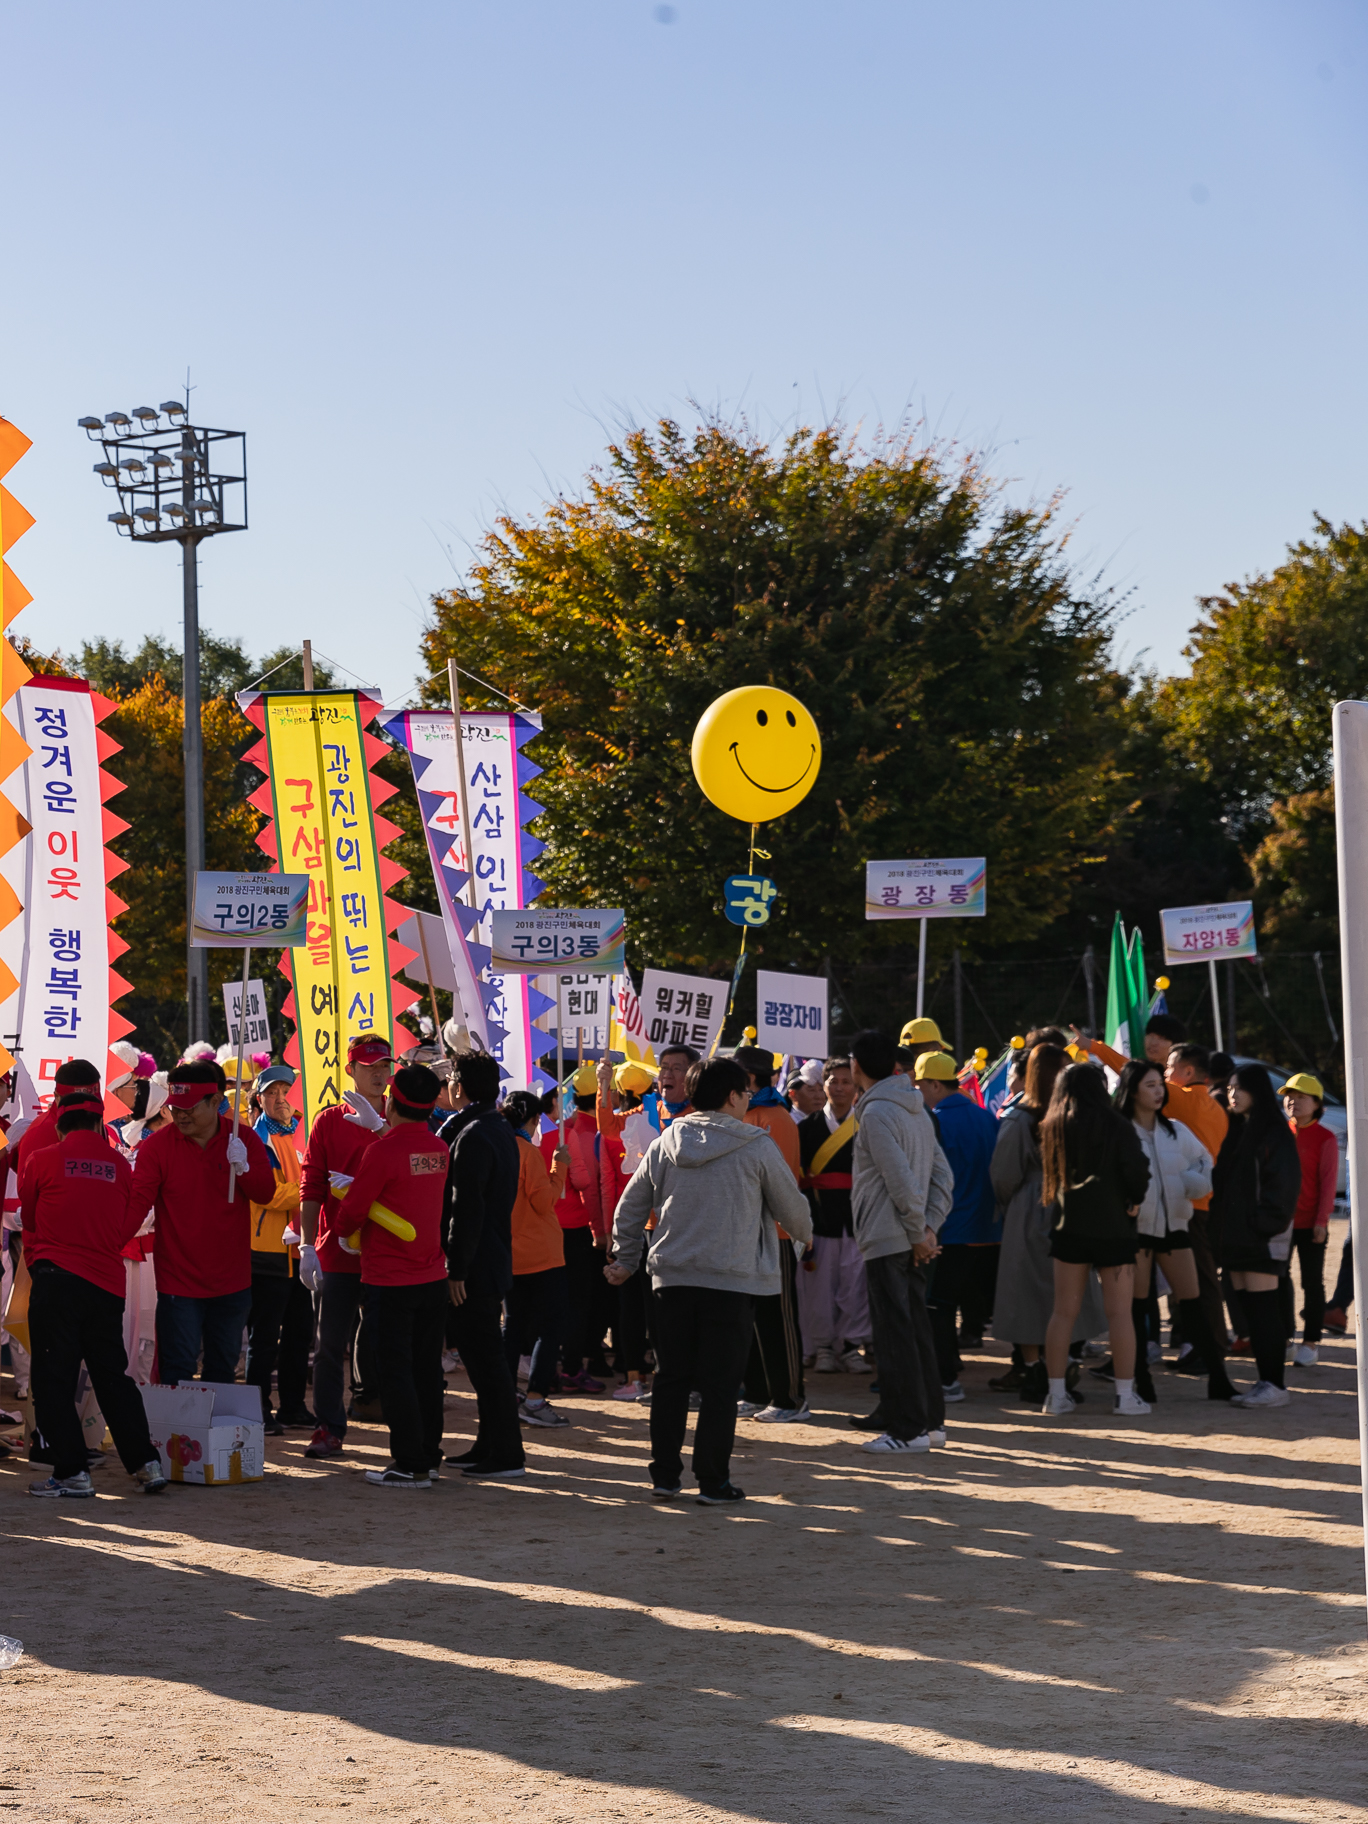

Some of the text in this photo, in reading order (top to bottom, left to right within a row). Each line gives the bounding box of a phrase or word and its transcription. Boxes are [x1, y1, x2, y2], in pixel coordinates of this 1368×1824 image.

[309, 706, 341, 725] 광진
[34, 706, 77, 814] 정겨운
[322, 744, 362, 872] 광진의
[470, 762, 505, 839] 산삼
[47, 830, 81, 901] 이웃
[217, 885, 290, 896] 2018 광진구민체육대회
[880, 884, 970, 908] 광장동
[213, 902, 290, 930] 구의2동
[515, 921, 535, 929] 2018
[341, 892, 370, 974] 뛰는
[511, 934, 601, 958] 구의3동
[1182, 927, 1241, 952] 자양1동
[43, 927, 82, 1039] 행복한
[567, 989, 599, 1016] 현대
[654, 986, 714, 1021] 워커힐
[764, 1000, 822, 1031] 광장자이
[348, 992, 374, 1043] 심
[649, 1017, 709, 1050] 아파트
[65, 1160, 116, 1180] 구의2동
[411, 1155, 447, 1172] 구의2동
